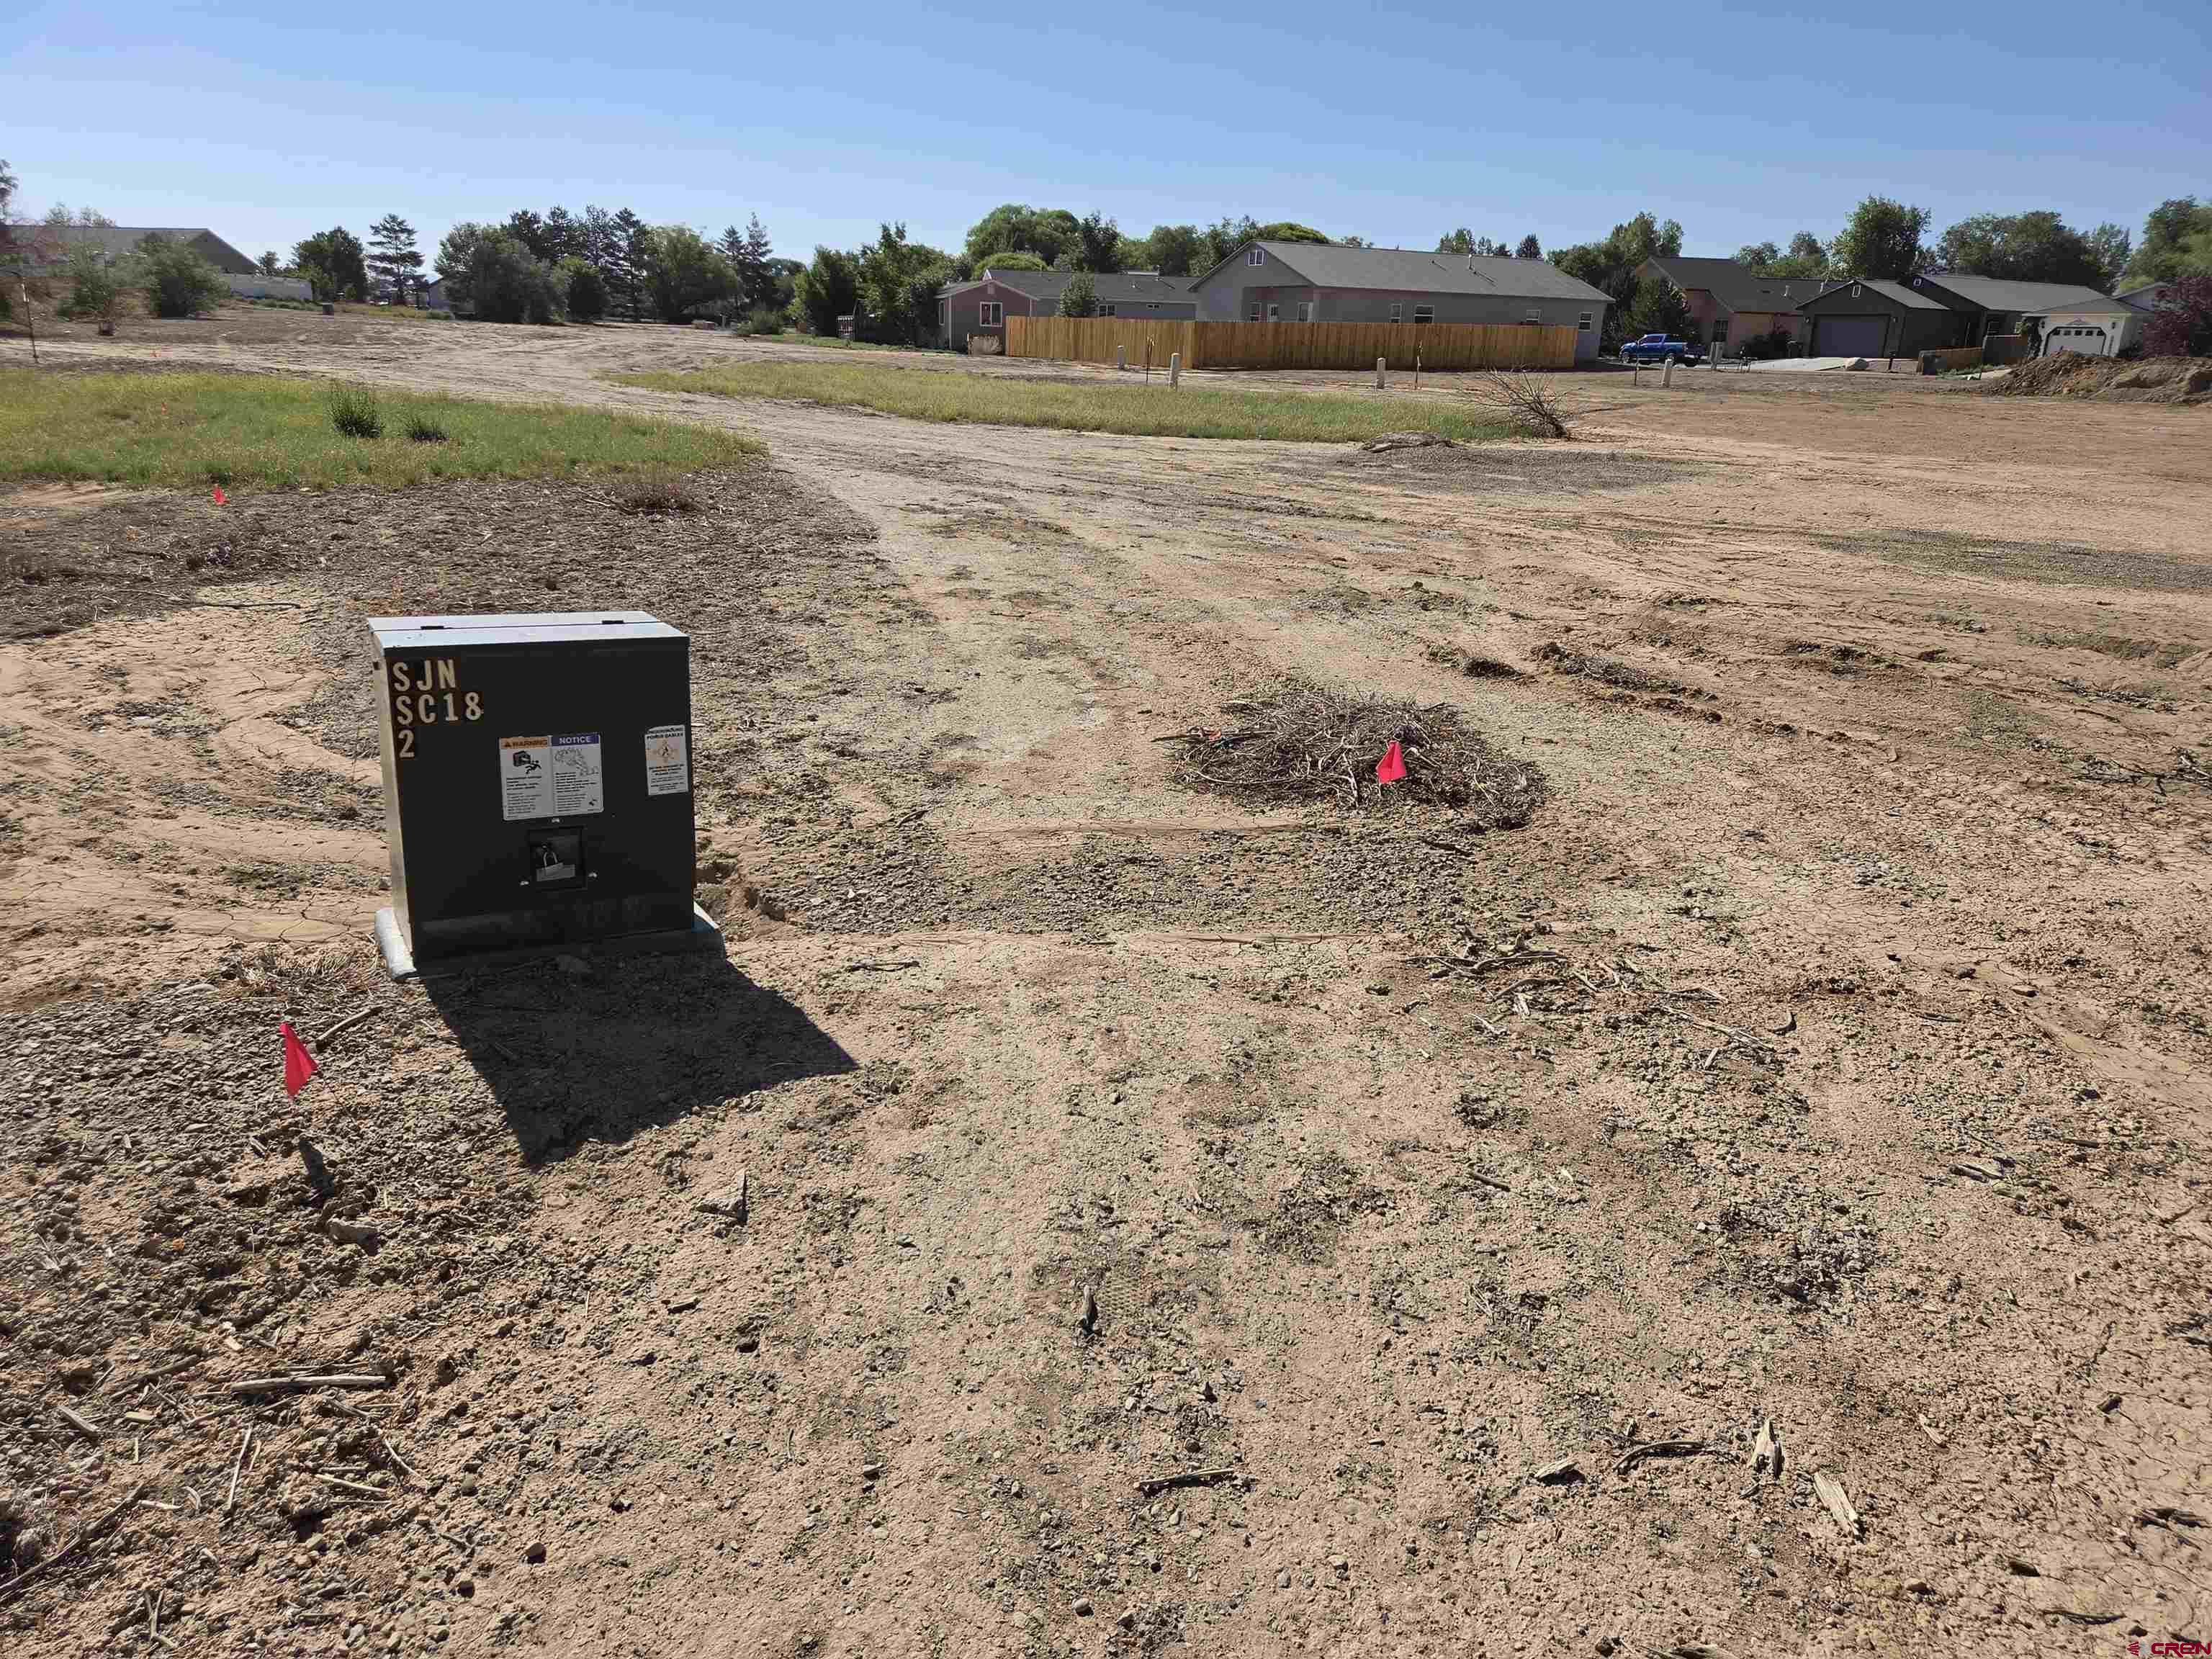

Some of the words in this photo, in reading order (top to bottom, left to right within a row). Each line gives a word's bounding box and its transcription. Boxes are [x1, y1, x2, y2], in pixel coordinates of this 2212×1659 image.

[392, 659, 456, 692] SJN
[395, 692, 482, 726] SC18
[398, 729, 415, 758] 2
